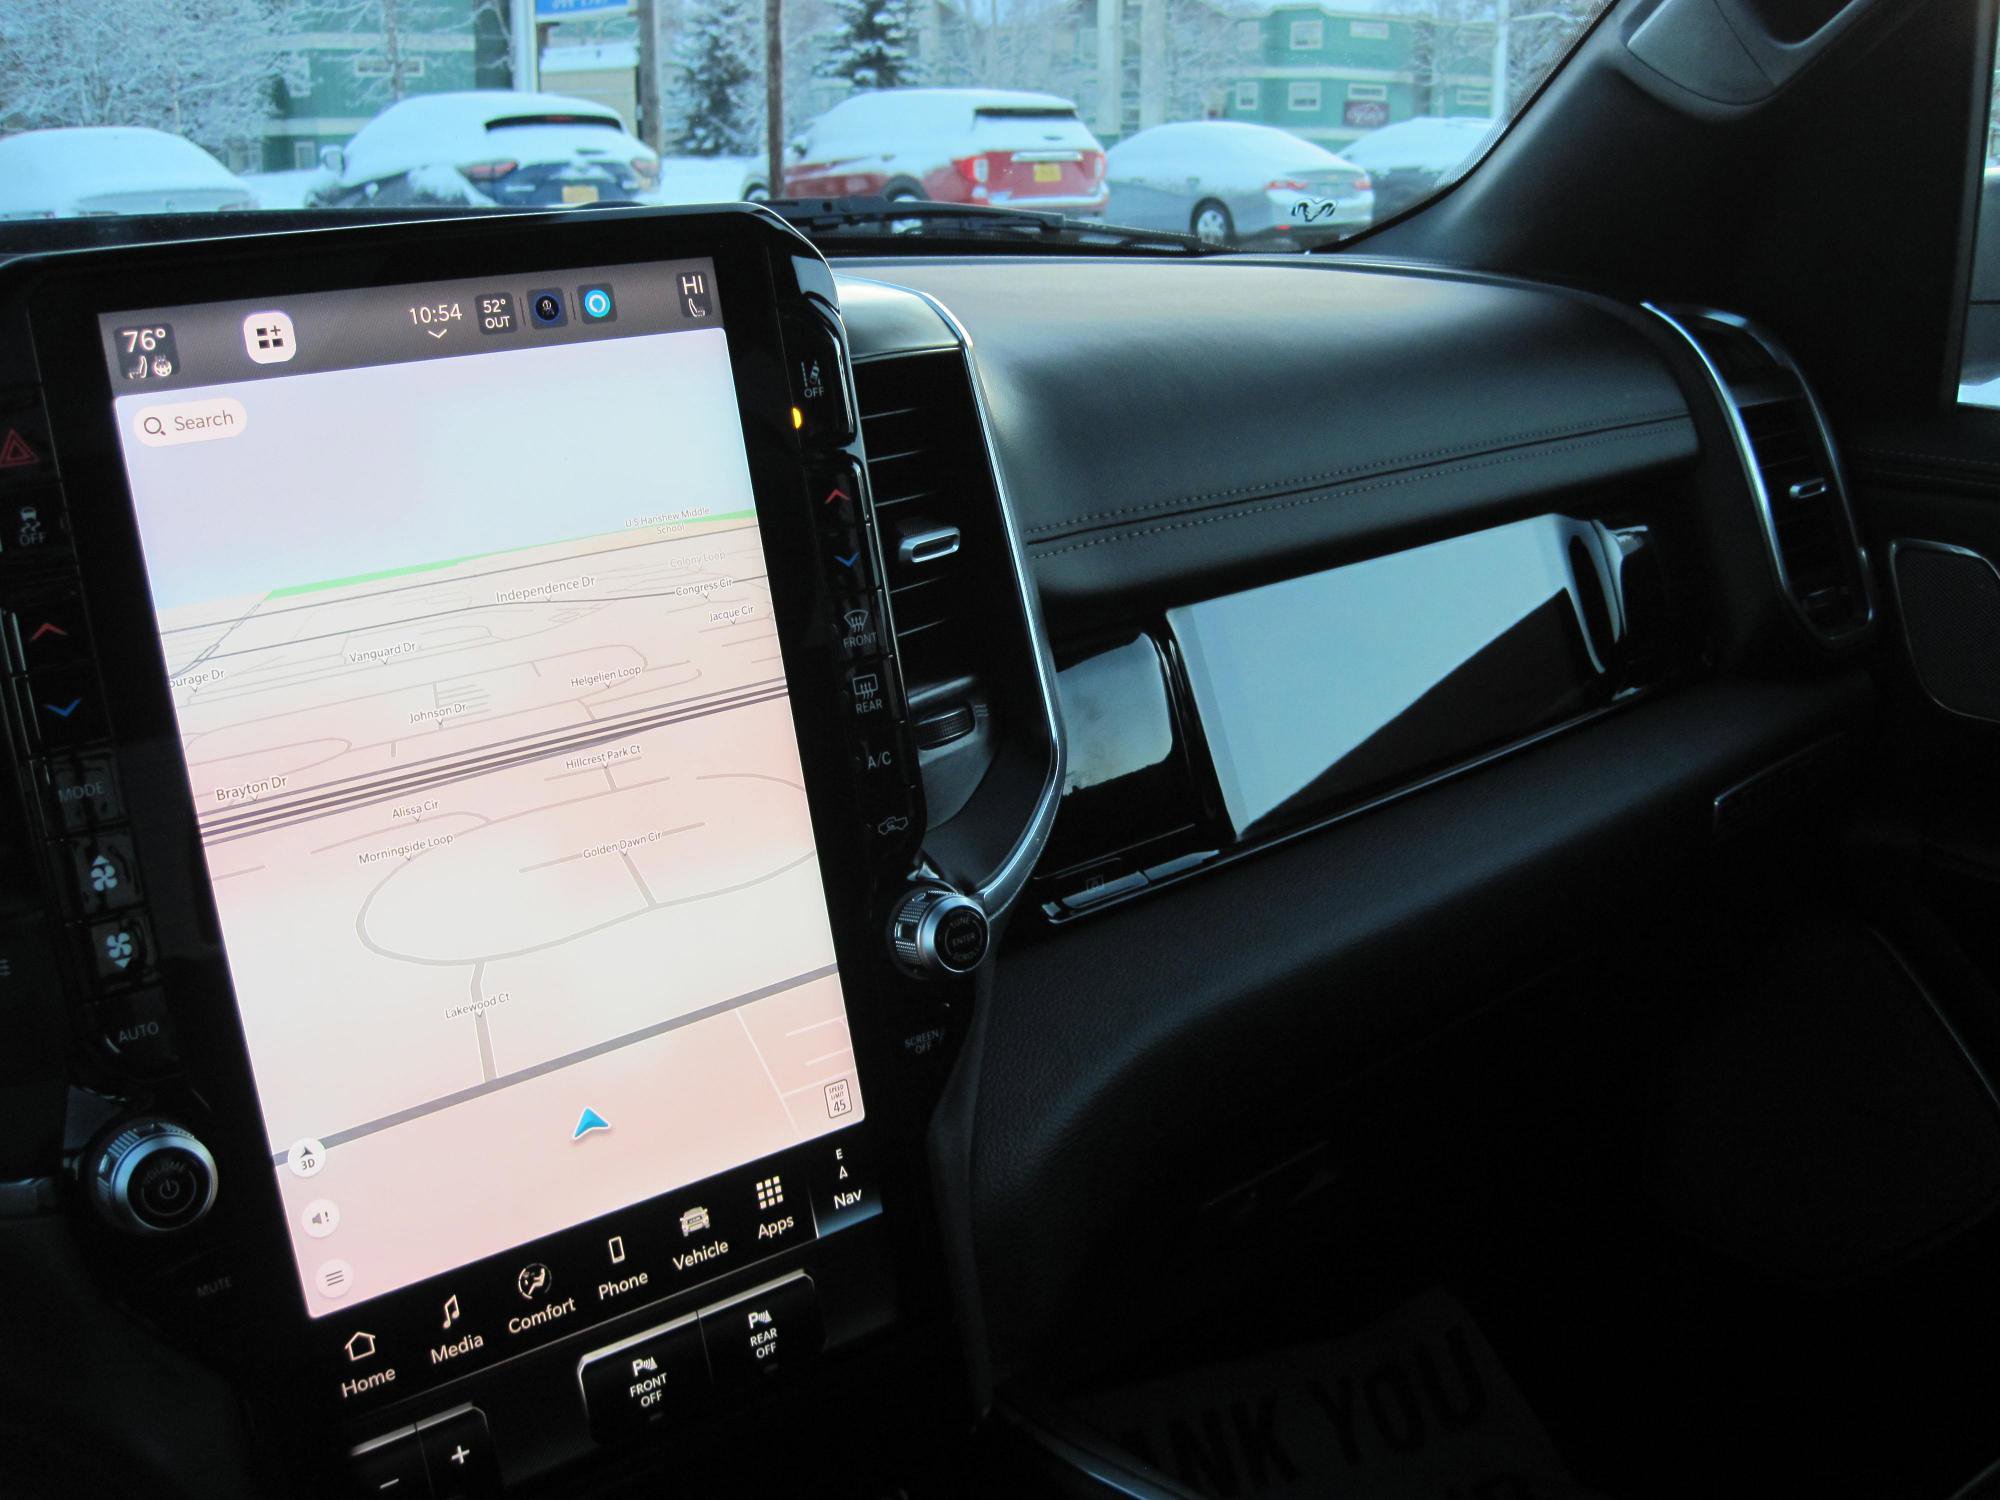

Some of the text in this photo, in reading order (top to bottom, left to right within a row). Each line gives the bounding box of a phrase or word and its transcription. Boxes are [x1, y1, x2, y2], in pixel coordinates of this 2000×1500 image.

[682, 275, 704, 295] HI
[410, 303, 463, 326] 10:54
[483, 298, 506, 314] 52°
[485, 316, 510, 329] OUT
[122, 328, 166, 352] 76°
[803, 386, 825, 399] OFF
[173, 409, 235, 431] Search
[681, 506, 711, 518] Middle
[19, 531, 47, 547] OFF
[656, 523, 686, 535] School
[670, 551, 726, 569] Colony Loop
[495, 576, 596, 602] Independence Dr
[675, 577, 733, 597] Congress Cir
[709, 605, 755, 623] Jacque Cir
[843, 632, 878, 648] FRONT
[349, 642, 417, 663] Vanguard Dr
[211, 669, 224, 680] Dr
[570, 665, 642, 688] Helgelien Loop
[409, 703, 466, 724] Johnson Dr
[855, 699, 884, 714] REAR
[566, 744, 642, 769] Hillcrest Park Ct
[867, 751, 892, 770] A/C
[58, 781, 105, 802] MODE
[216, 775, 288, 801] Brayton Dr
[391, 800, 439, 819] Alissa Cir
[358, 833, 454, 864] Morningside Loop
[583, 830, 662, 859] Golden Dawn Cir
[445, 993, 511, 1019] Lakewood Ct
[118, 1021, 160, 1044] AUTO
[904, 1028, 939, 1048] SCREEN
[914, 1040, 933, 1056] OFF
[828, 1084, 844, 1095] SPEED
[833, 1100, 847, 1113] 45
[301, 1157, 316, 1171] 3D
[835, 1148, 843, 1160] E
[833, 1189, 862, 1210] Nav
[757, 1214, 794, 1240] Apps
[672, 1238, 730, 1271] Vehicle
[196, 1275, 233, 1297] MUTE
[598, 1270, 649, 1300] Phone
[508, 1297, 577, 1334] Comfort
[749, 1327, 778, 1348] REAR
[430, 1334, 484, 1365] Media
[756, 1341, 777, 1359] OFF
[341, 1368, 397, 1398] Home
[629, 1372, 668, 1399] FRONT
[640, 1389, 663, 1408] OFF
